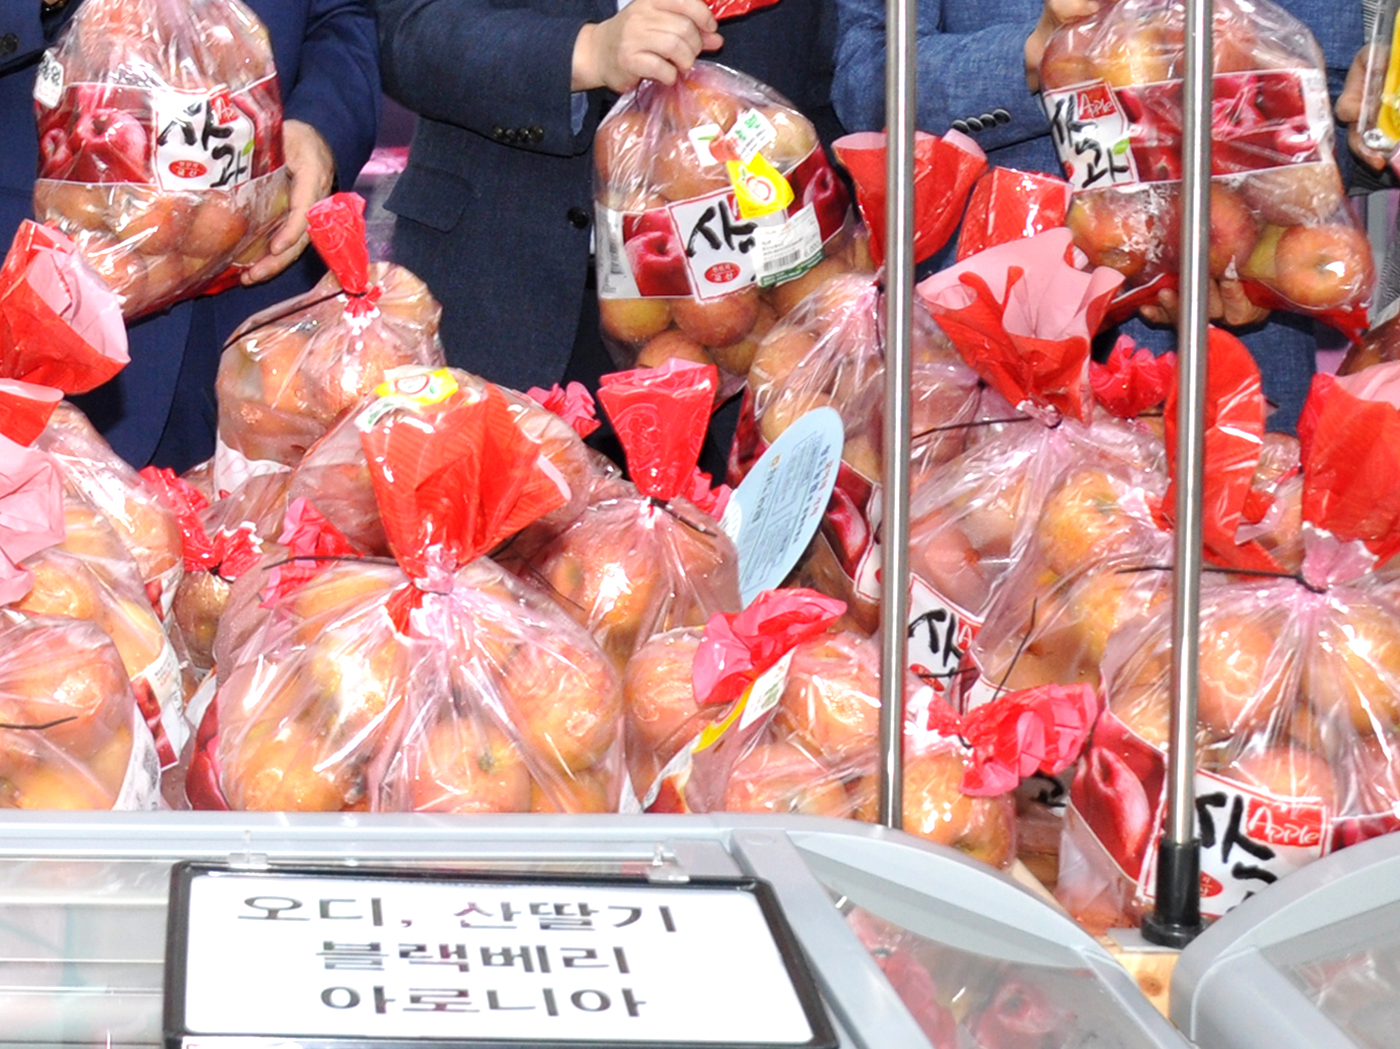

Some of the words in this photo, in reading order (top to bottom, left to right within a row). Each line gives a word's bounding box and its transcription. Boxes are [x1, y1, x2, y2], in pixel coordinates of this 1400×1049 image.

[1078, 93, 1115, 117] Apple
[157, 99, 248, 188] 사과
[686, 200, 758, 258] 사
[1248, 805, 1320, 844] Apple
[453, 901, 679, 933] 산딸기
[315, 940, 633, 975] 블랙베리
[320, 985, 648, 1018] 아로니아
